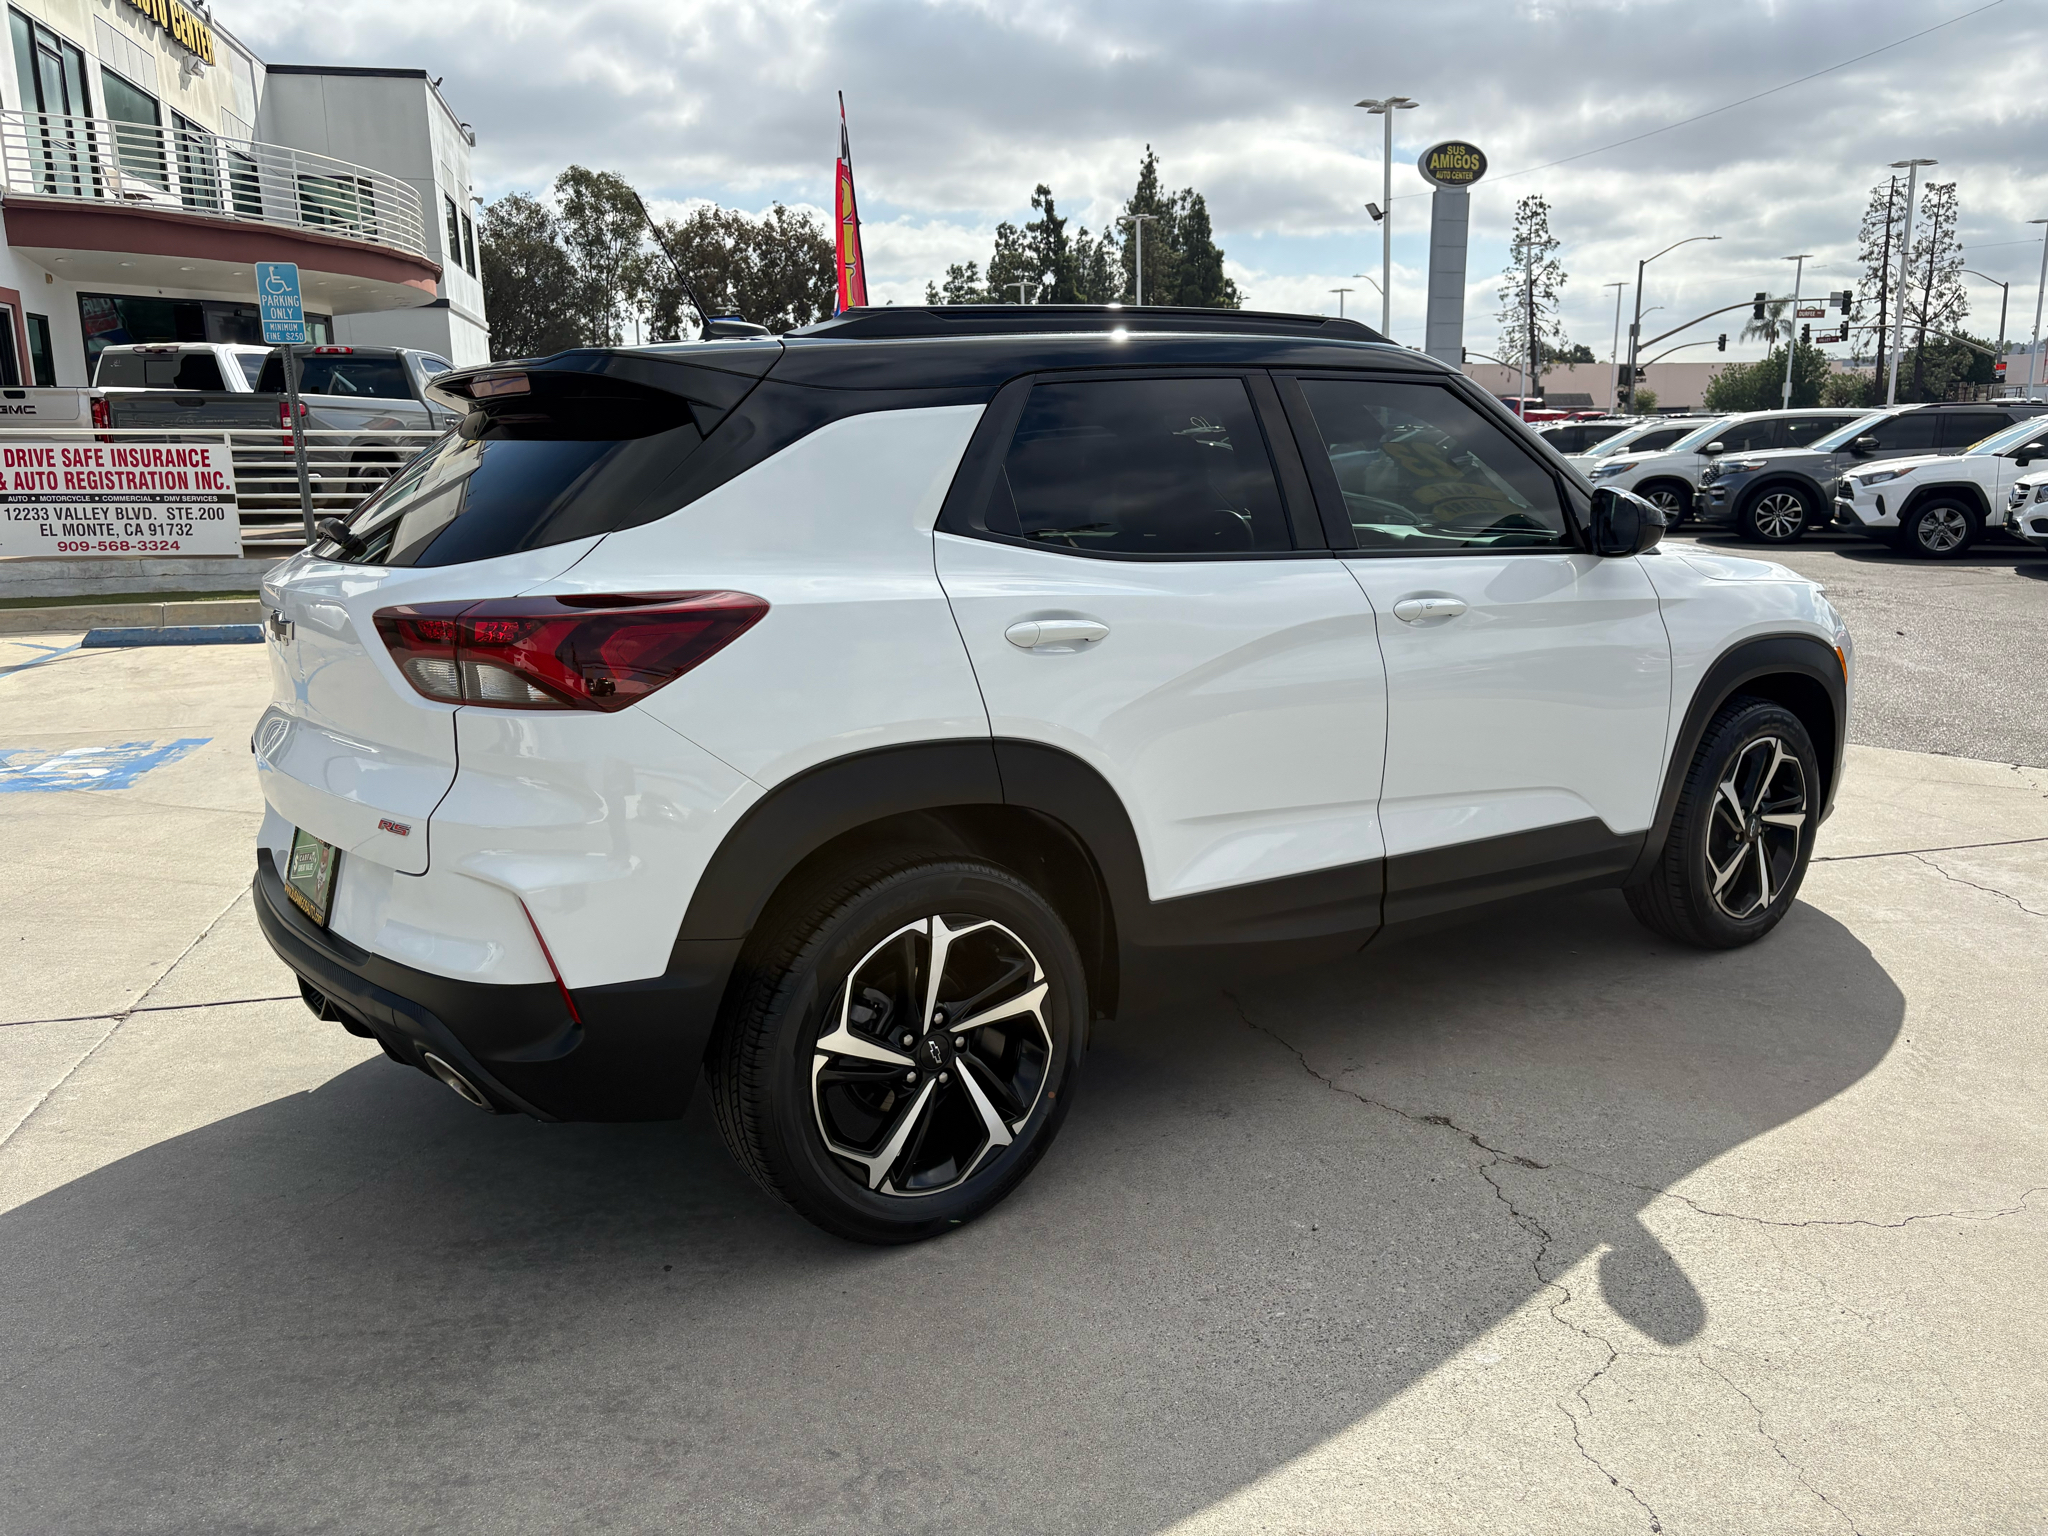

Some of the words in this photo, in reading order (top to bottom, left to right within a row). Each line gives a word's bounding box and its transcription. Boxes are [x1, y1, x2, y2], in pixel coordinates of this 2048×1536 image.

[130, 0, 169, 28] TO
[169, 0, 216, 67] CENTER
[1446, 145, 1466, 155] SUS
[1429, 153, 1480, 170] AMIGOS
[1436, 170, 1451, 179] AUTO
[1451, 171, 1473, 180] CENTER
[261, 294, 300, 307] PARKING
[270, 307, 293, 319] ONLY
[269, 323, 298, 332] MINIMUM
[266, 332, 281, 341] FINE
[285, 332, 304, 341] $250
[3, 448, 57, 468] DRIVE
[61, 448, 105, 468] SAFE
[110, 448, 211, 468] INSURANCE
[14, 471, 58, 491] AUTO
[63, 470, 189, 490] REGISTRATION
[194, 471, 231, 490] INC.
[4, 507, 50, 521] 12233
[53, 507, 110, 521] VALLEY
[115, 507, 157, 521] BLVD.
[166, 507, 225, 521] STE.200
[39, 523, 58, 537] EL
[62, 523, 120, 539] MONTE,
[124, 522, 144, 537] CA
[148, 522, 194, 537] 91732
[57, 540, 181, 552] 909-568-3324
[378, 818, 411, 836] RS
